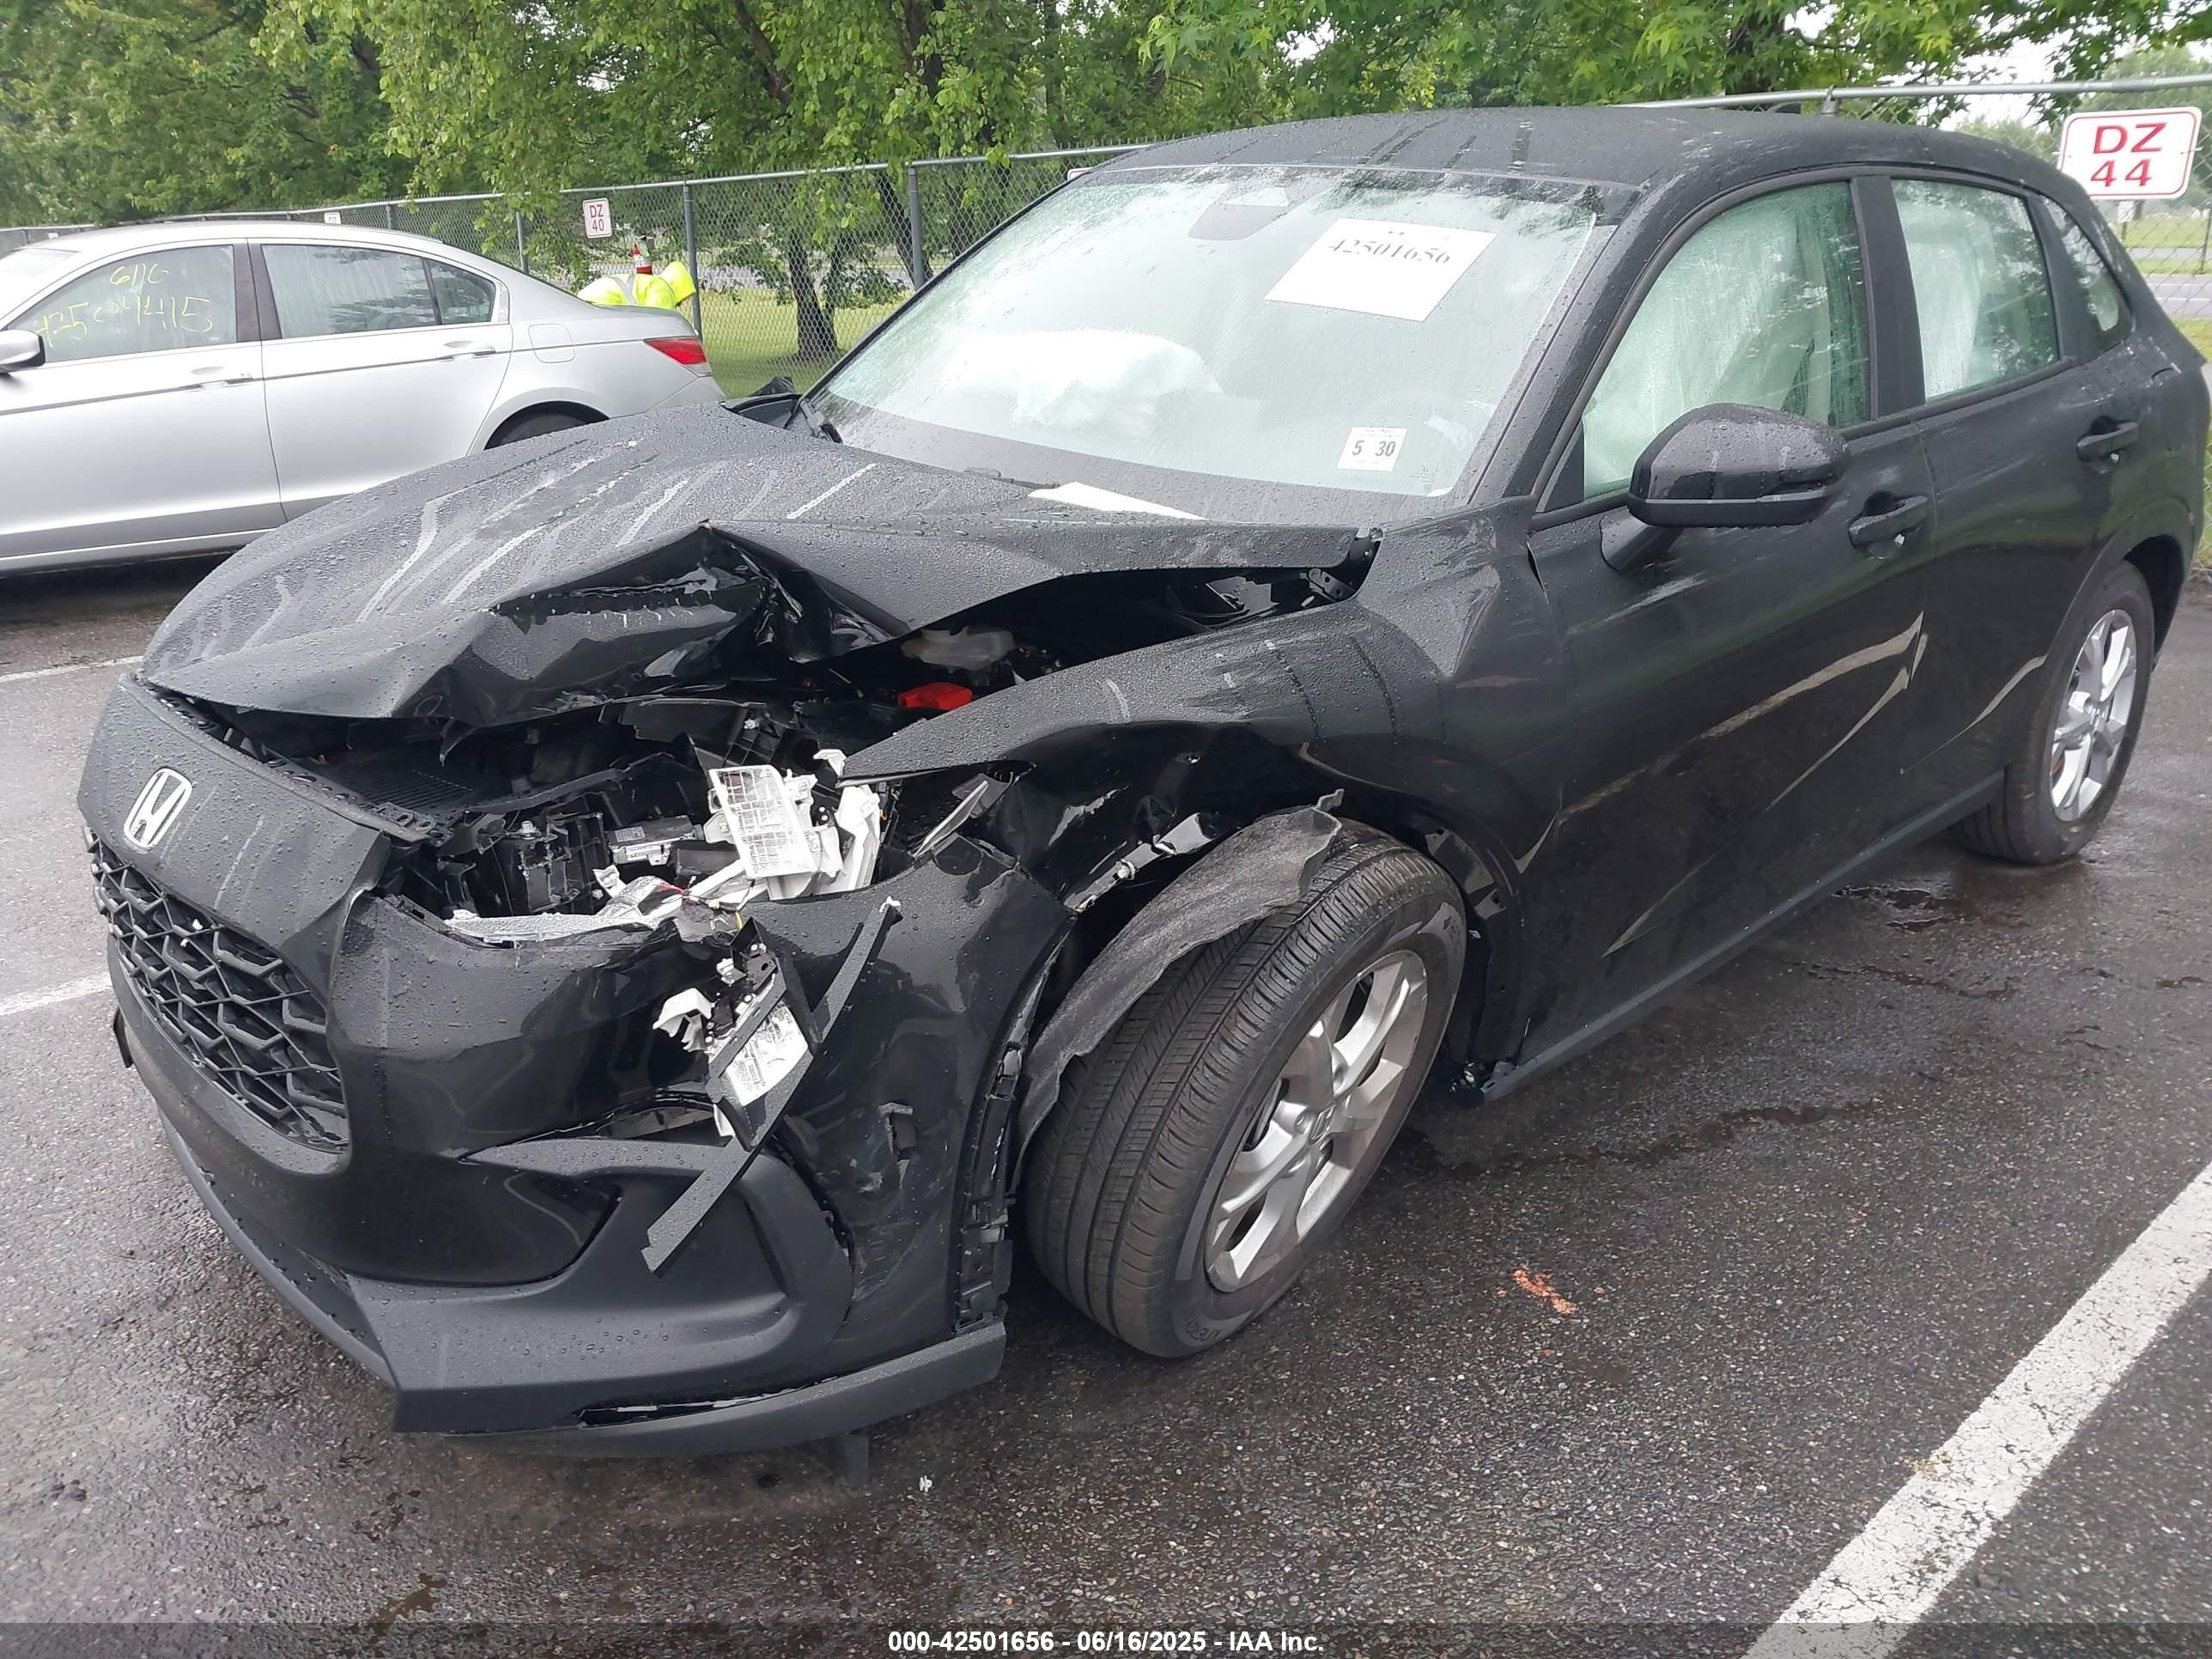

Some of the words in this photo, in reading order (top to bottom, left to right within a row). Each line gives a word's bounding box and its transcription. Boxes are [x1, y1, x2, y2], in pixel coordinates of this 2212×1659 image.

[2093, 122, 2167, 155] DZ
[2090, 159, 2153, 187] 44
[590, 204, 605, 218] DZ
[592, 218, 605, 232] 40
[1352, 440, 1365, 456] 5
[1375, 441, 1396, 457] 30
